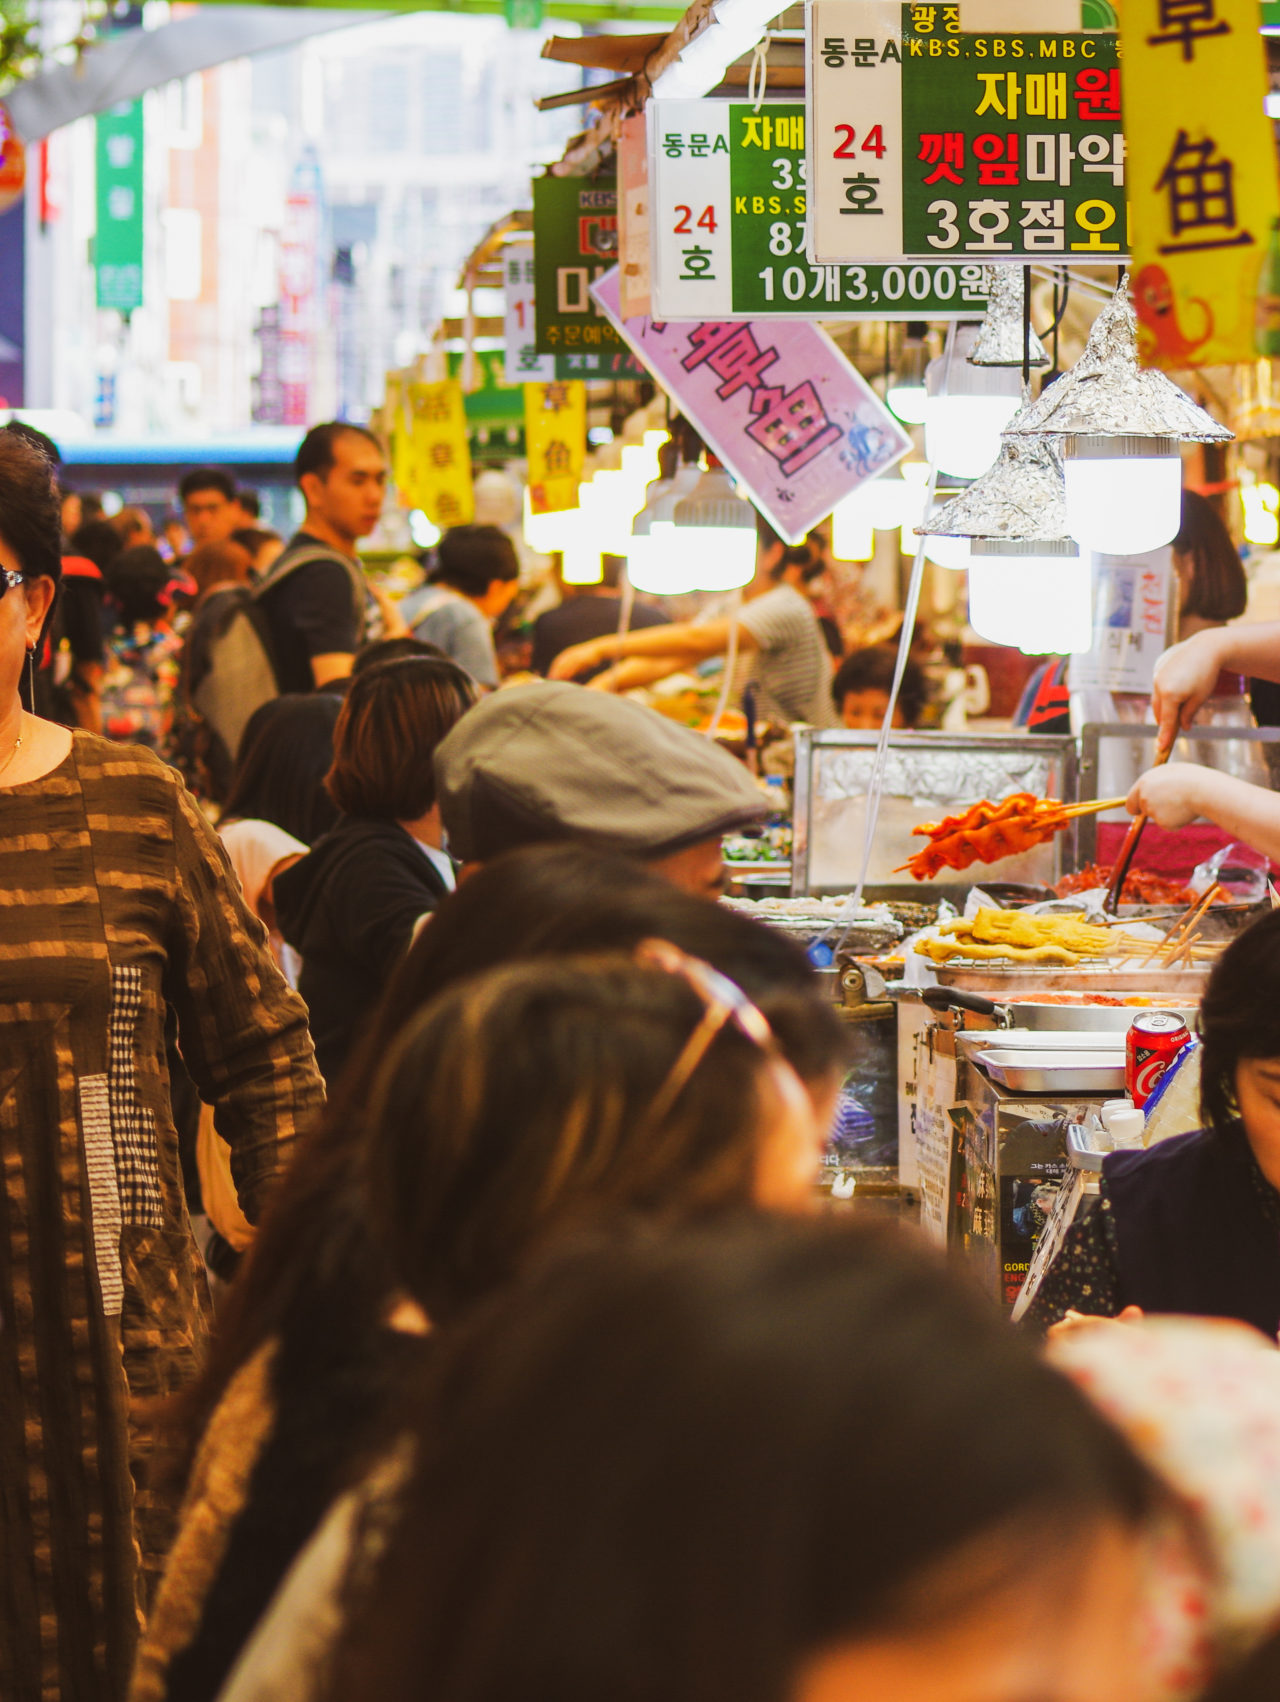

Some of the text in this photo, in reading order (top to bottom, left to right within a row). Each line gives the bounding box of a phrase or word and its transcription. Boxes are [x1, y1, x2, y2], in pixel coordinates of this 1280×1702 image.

[821, 38, 901, 67] 동문A
[662, 133, 729, 158] 동문A
[741, 116, 804, 151] 자매
[833, 124, 886, 159] 24
[917, 132, 1127, 187] 깻잎마약
[840, 172, 883, 215] 호
[673, 205, 718, 234] 24
[926, 199, 1132, 251] 3호점오
[679, 245, 716, 280] 호
[758, 266, 990, 303] 10개3,000원
